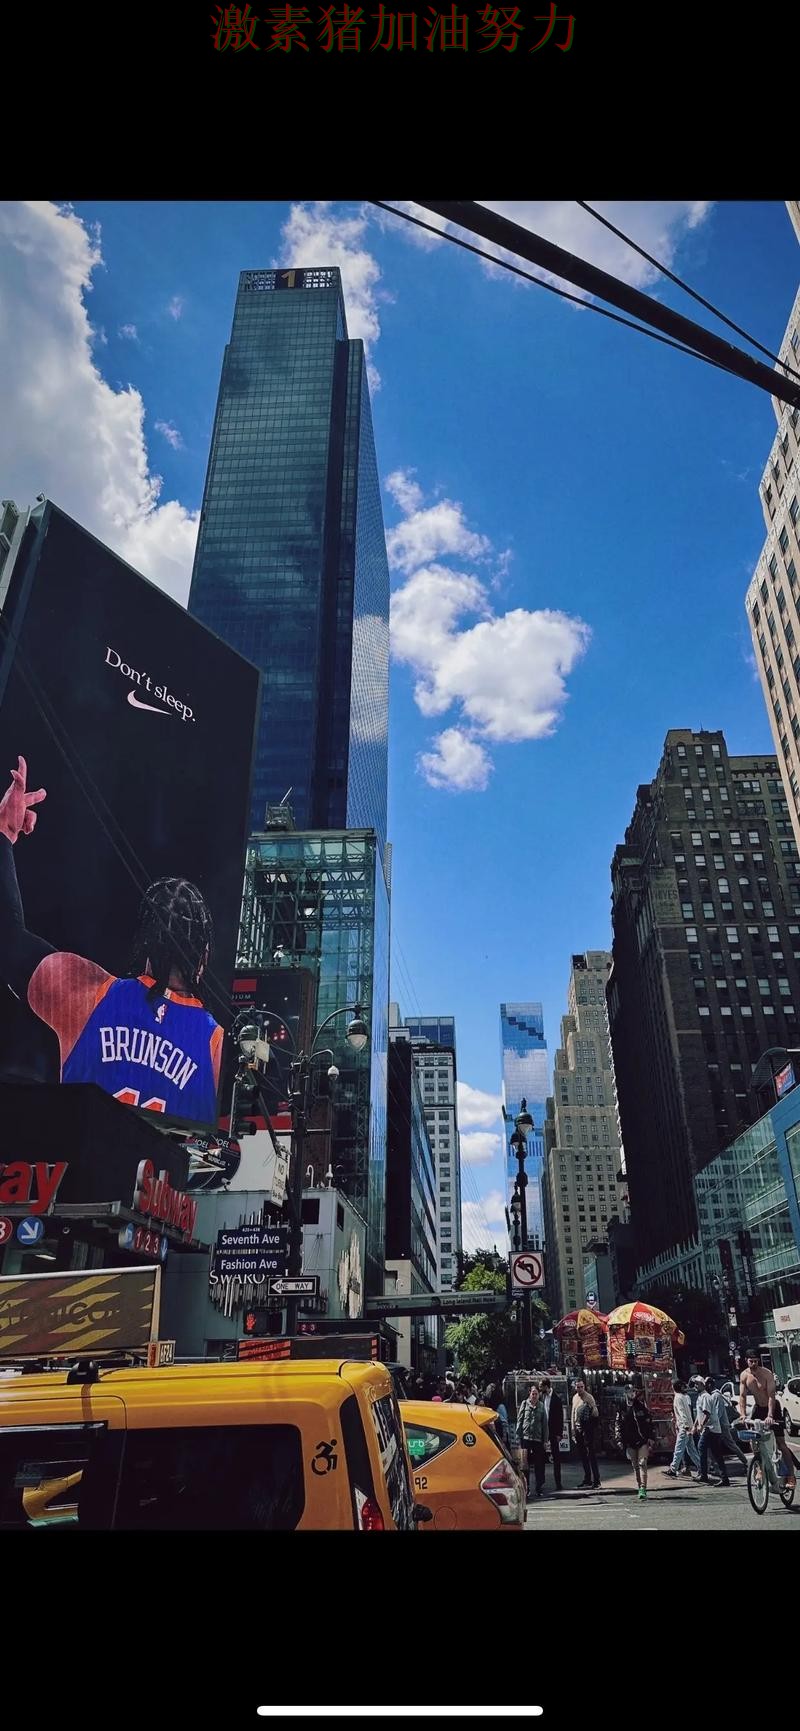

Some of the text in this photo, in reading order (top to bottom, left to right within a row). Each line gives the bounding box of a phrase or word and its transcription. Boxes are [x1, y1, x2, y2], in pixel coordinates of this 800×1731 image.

[281, 270, 296, 288] 1
[104, 646, 196, 722] Don't sleep.
[99, 1026, 198, 1091] BRUNSON
[0, 1160, 68, 1216] ay
[131, 1158, 198, 1244] Subway
[136, 1231, 159, 1254] 1 2 3
[221, 1233, 280, 1245] Seventh Ave
[220, 1258, 278, 1270] Fashion Ave
[275, 1282, 309, 1290] ONE WAY
